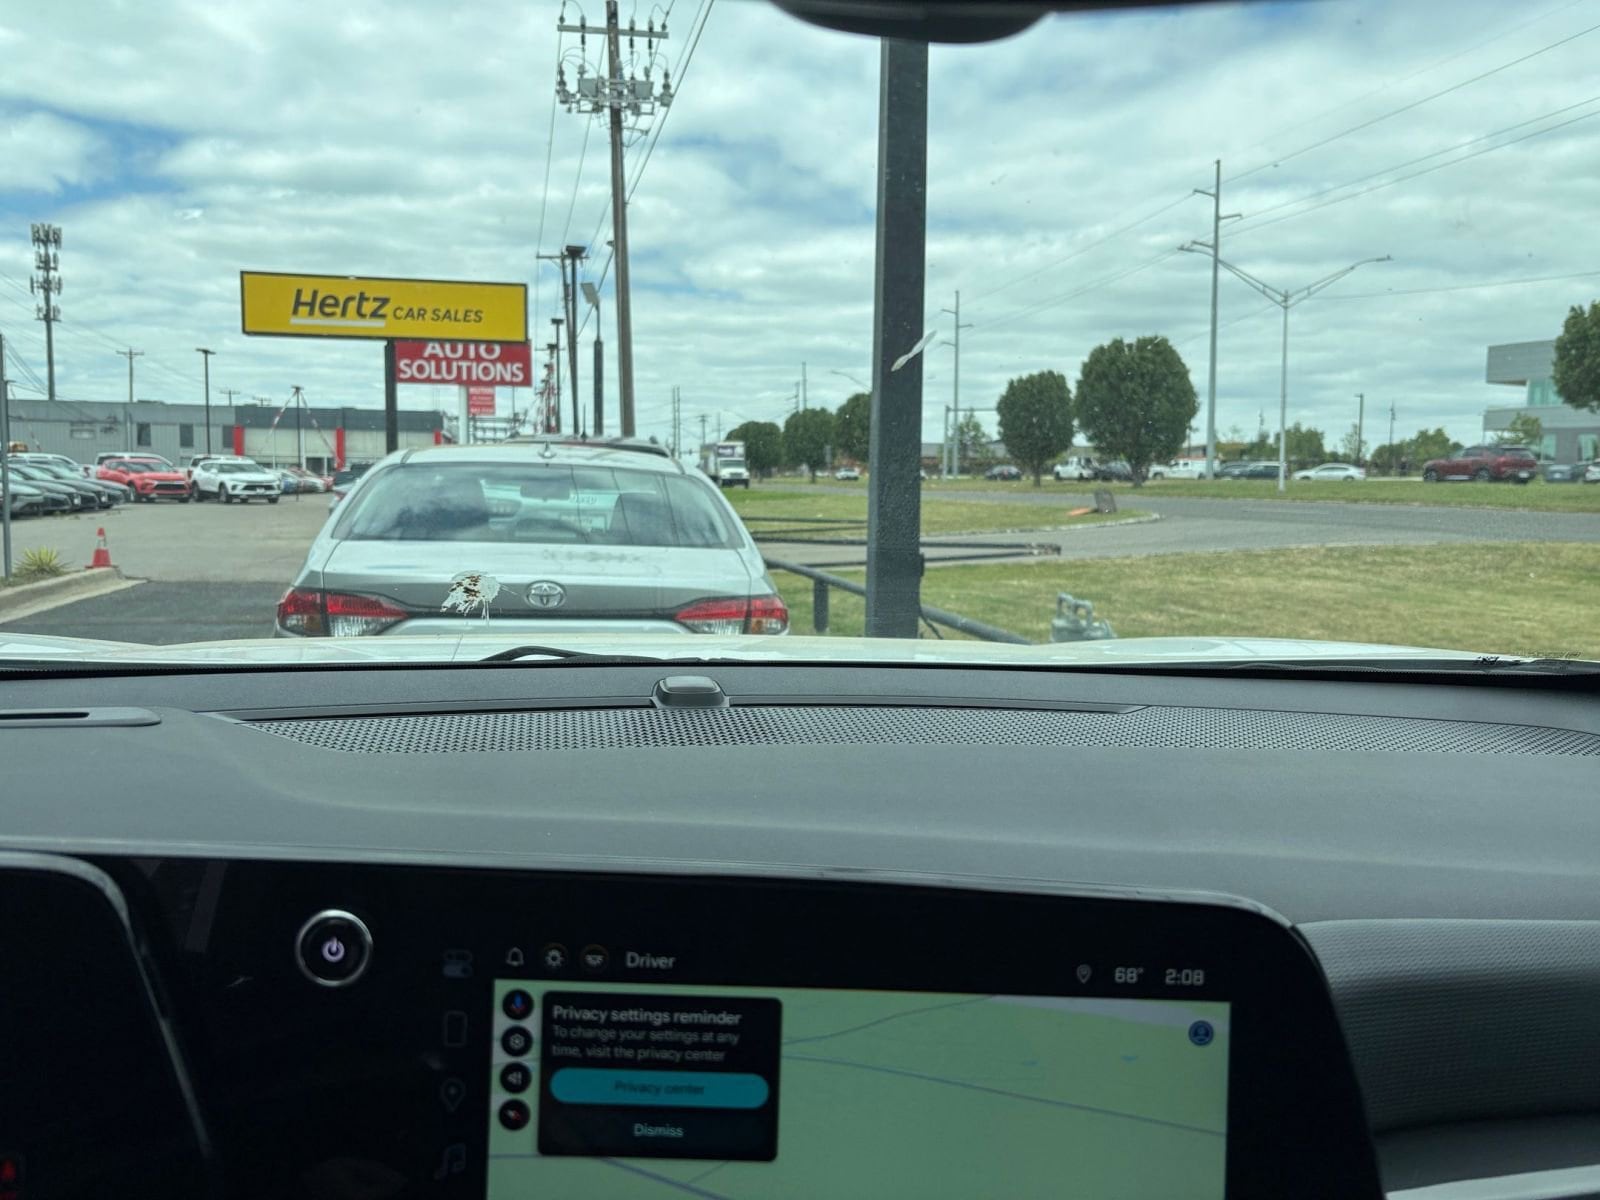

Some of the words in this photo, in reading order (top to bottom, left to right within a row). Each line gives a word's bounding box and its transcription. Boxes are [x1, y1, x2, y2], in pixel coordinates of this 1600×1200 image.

[291, 288, 391, 319] Hertz
[393, 307, 427, 321] CAR
[430, 308, 483, 323] SALES
[422, 342, 501, 359] AUTO
[398, 359, 525, 383] SOLUTIONS
[625, 951, 676, 969] Driver
[1164, 968, 1206, 987] 2:08
[552, 1005, 607, 1023] Privacy
[610, 1008, 671, 1026] settings
[672, 1010, 743, 1026] reminder
[552, 1025, 567, 1038] To
[569, 1025, 617, 1041] change
[618, 1030, 647, 1043] your
[650, 1028, 700, 1044] settings
[701, 1031, 716, 1043] at
[717, 1033, 740, 1046] any
[552, 1044, 583, 1058] time,
[585, 1046, 612, 1058] visit
[613, 1047, 635, 1059] the
[636, 1048, 682, 1063] privacy
[683, 1049, 726, 1063] center
[614, 1080, 661, 1096] Privacy
[664, 1082, 705, 1096] center
[633, 1123, 685, 1138] Dismiss
